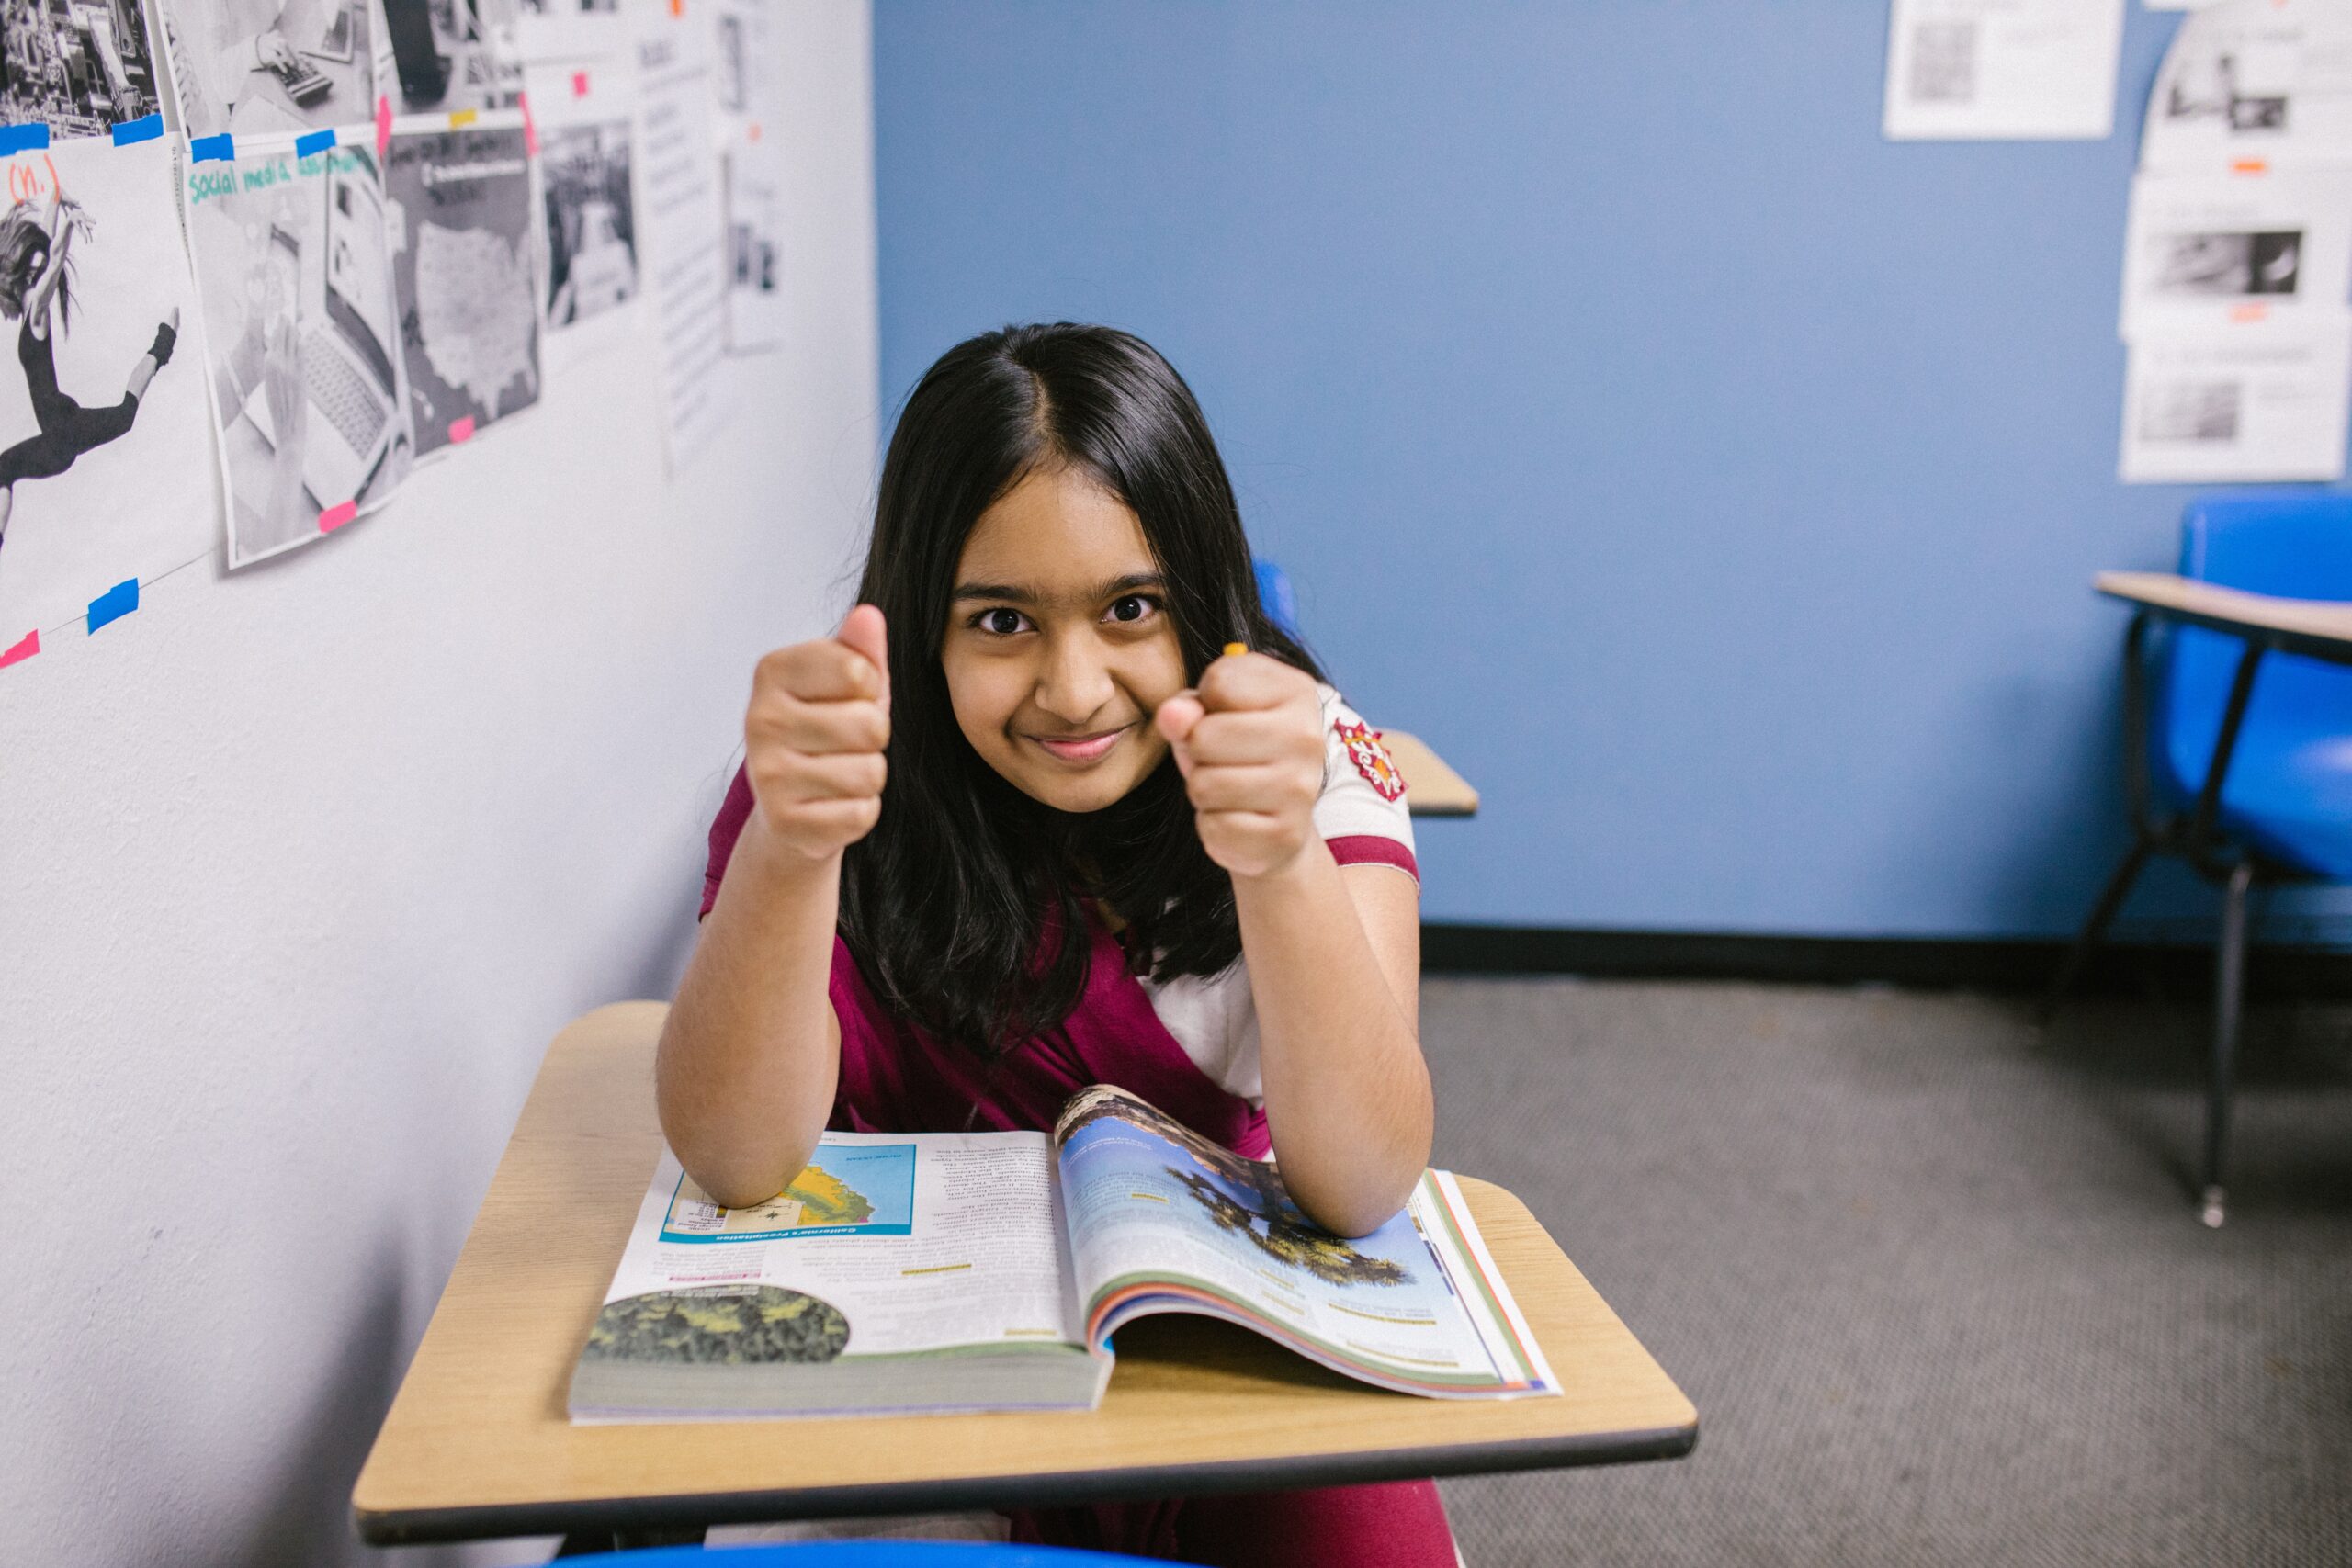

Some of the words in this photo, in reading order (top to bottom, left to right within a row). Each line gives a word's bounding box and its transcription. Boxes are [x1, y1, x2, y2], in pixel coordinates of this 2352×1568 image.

[188, 164, 238, 205] social
[243, 159, 291, 193] media
[792, 1227, 856, 1235] California's
[716, 1232, 789, 1241] Precipitation
